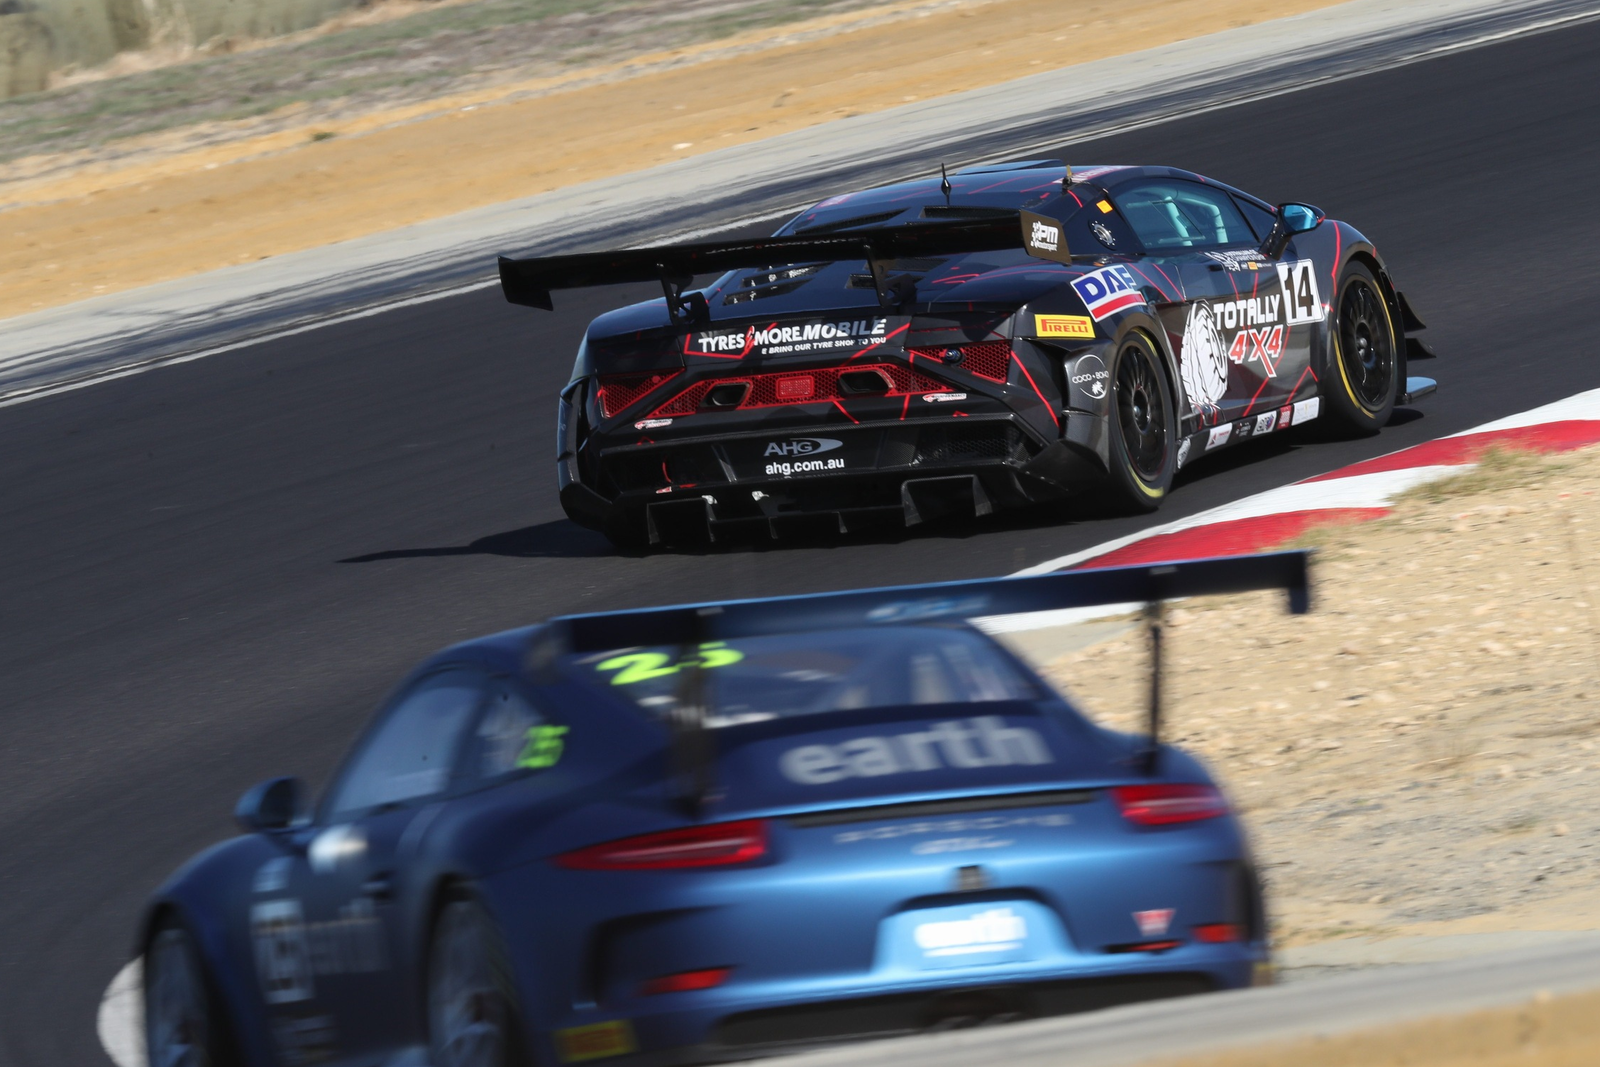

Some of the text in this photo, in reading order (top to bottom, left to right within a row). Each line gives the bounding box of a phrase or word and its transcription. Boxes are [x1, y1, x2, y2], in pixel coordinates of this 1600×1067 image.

[1073, 266, 1134, 305] DAF
[1283, 265, 1314, 319] 14
[1213, 294, 1280, 331] TOTALLY
[1041, 318, 1088, 333] PIRELLI
[698, 333, 745, 353] TYRES
[768, 344, 793, 355] BRING
[795, 340, 812, 351] OUR
[813, 340, 833, 350] TYRE
[834, 338, 855, 348] SHOP
[857, 337, 868, 346] TO
[870, 336, 887, 345] YOU
[1072, 373, 1093, 384] COCO
[763, 441, 813, 457] AHG
[765, 458, 845, 476] ahg.com.au
[779, 715, 1054, 786] earth
